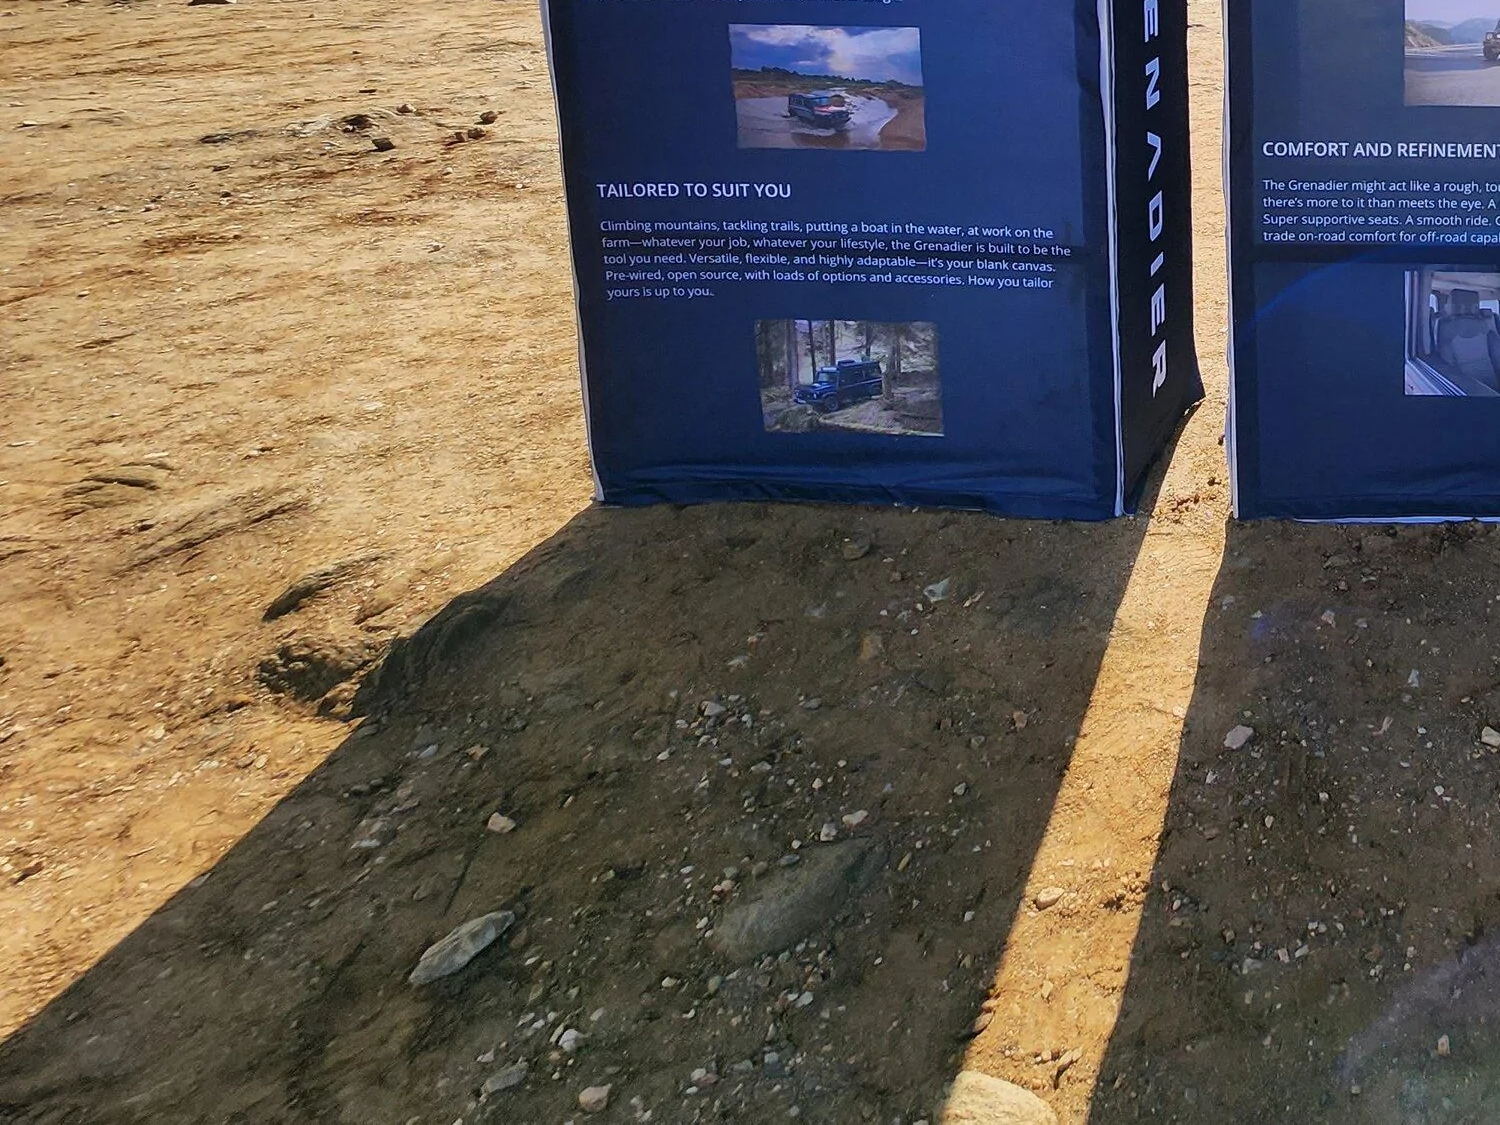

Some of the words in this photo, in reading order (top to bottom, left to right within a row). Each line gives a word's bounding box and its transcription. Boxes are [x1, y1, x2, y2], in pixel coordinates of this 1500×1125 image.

[1262, 141, 1349, 156] COMFORT
[1352, 142, 1391, 156] AND
[595, 183, 679, 197] TAILORED
[683, 183, 707, 197] TO
[712, 183, 750, 197] SUIT
[753, 183, 791, 197] YOU
[1263, 230, 1295, 241] trade
[1298, 230, 1345, 241] on-road
[1348, 230, 1396, 242] comfort
[1399, 230, 1416, 241] for
[1419, 230, 1467, 242] off-road
[666, 271, 697, 282] open
[699, 271, 742, 281] source,
[744, 269, 770, 279] with
[772, 269, 805, 280] loads
[807, 270, 819, 280] of
[822, 271, 866, 284] options
[869, 271, 892, 282] and
[967, 274, 995, 286] How
[996, 278, 1019, 290] you
[1022, 276, 1054, 288] tailor
